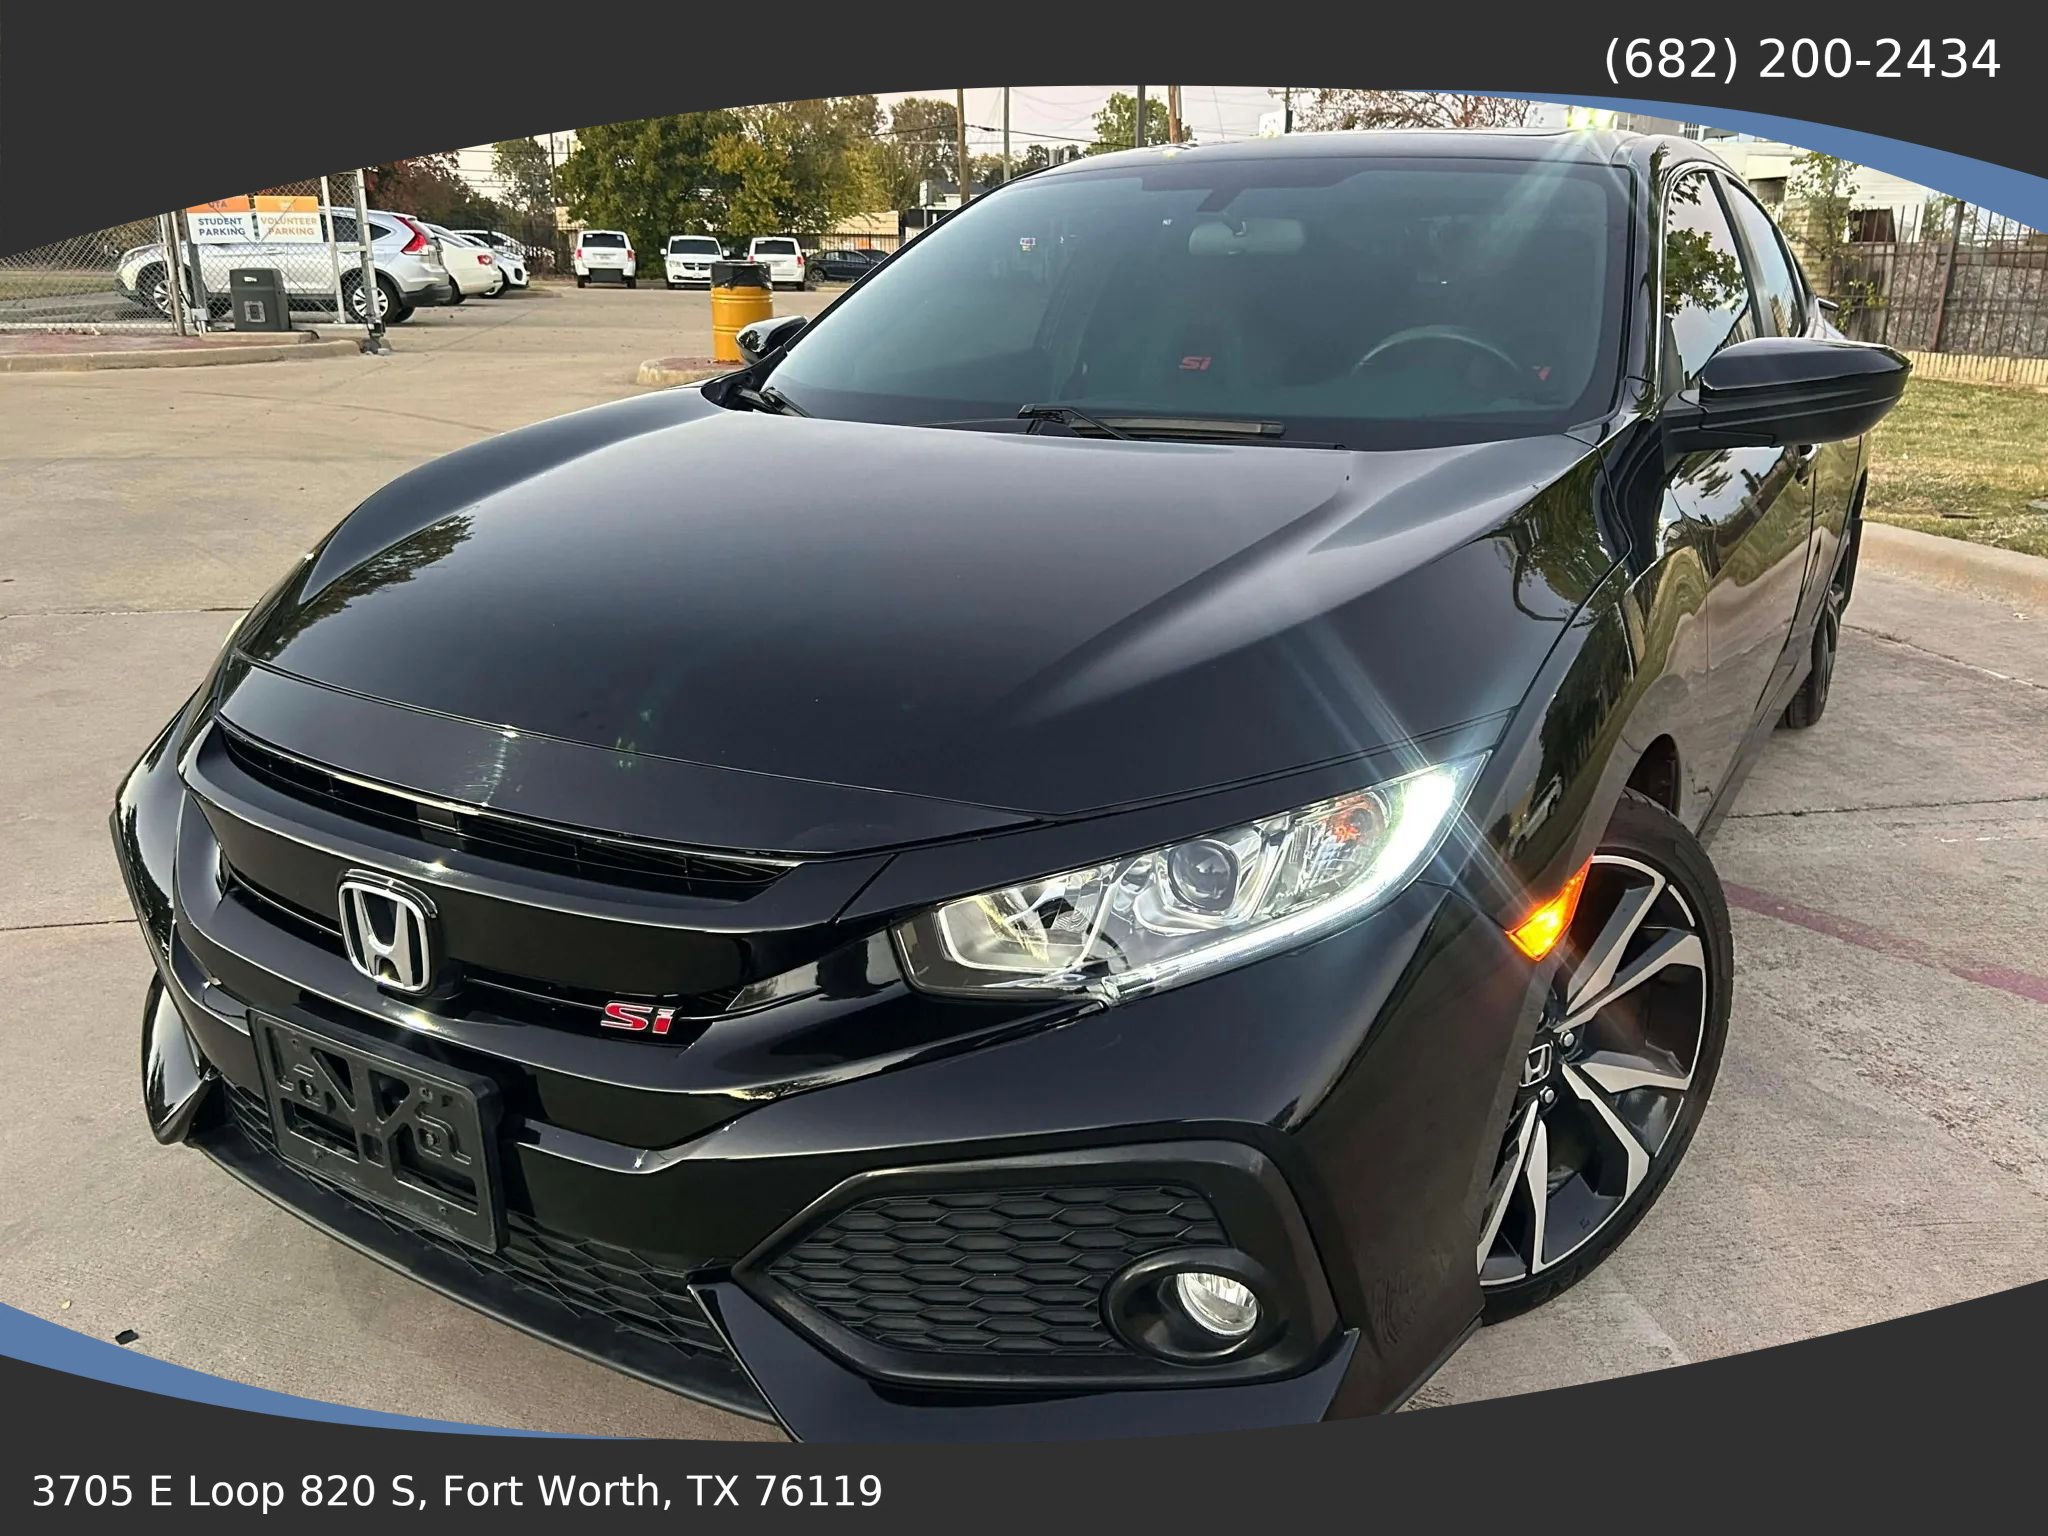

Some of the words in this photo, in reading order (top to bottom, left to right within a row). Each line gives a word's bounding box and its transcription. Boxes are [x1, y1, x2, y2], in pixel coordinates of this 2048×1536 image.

[198, 217, 242, 226] STUDENT
[260, 217, 317, 225] VOLUNTEER
[199, 227, 246, 236] PARKING
[268, 227, 315, 236] PARKING
[600, 1002, 676, 1034] Si
